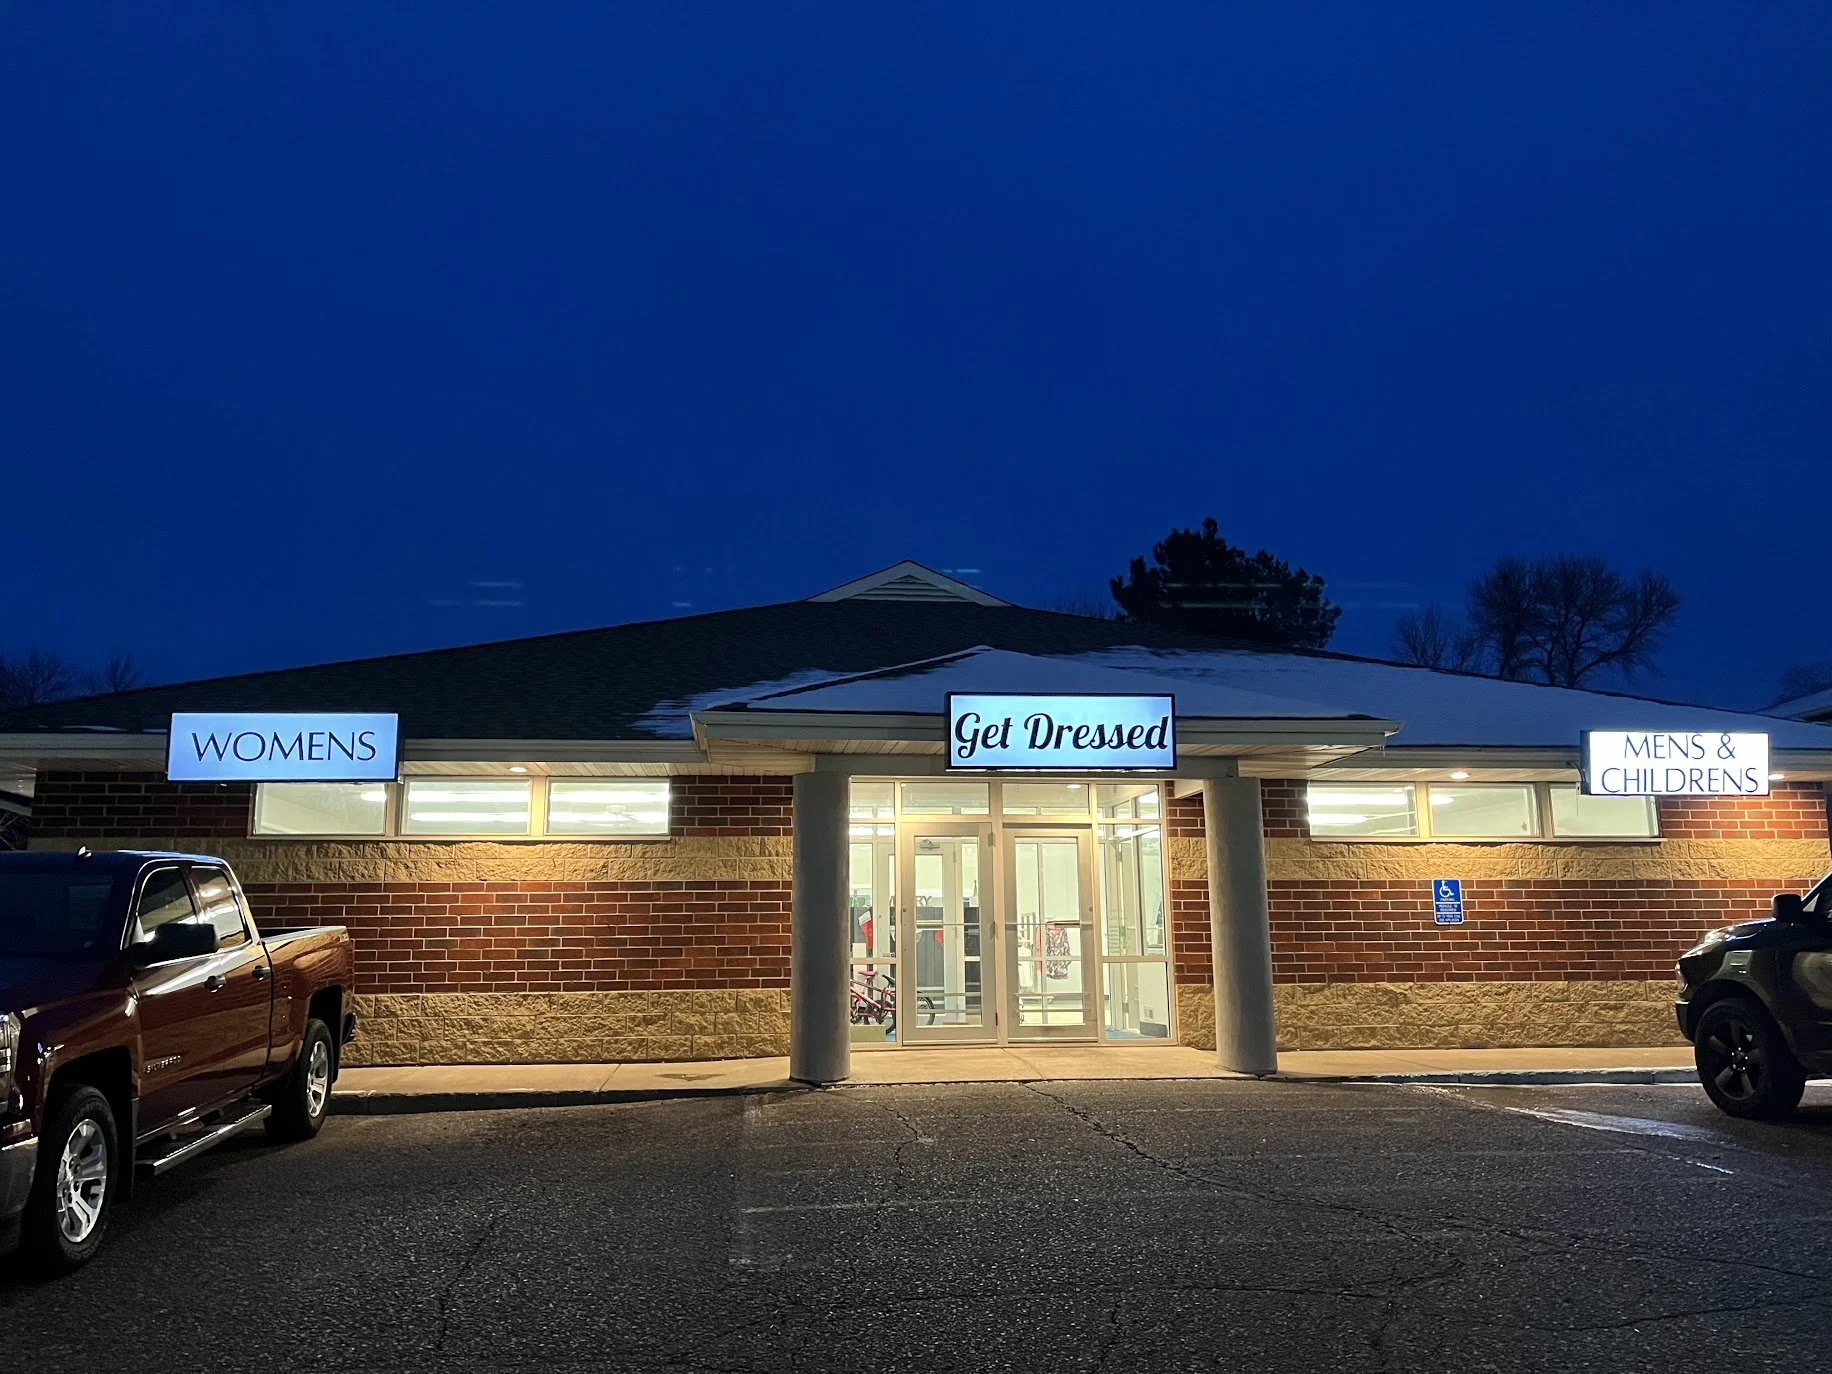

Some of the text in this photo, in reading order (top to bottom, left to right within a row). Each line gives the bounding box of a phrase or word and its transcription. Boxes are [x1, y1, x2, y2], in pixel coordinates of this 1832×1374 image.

[192, 731, 376, 761] WOMENS
[955, 712, 1169, 758] Get Dressed
[1625, 733, 1736, 759] MENS &
[1601, 768, 1759, 792] CHILDRENS
